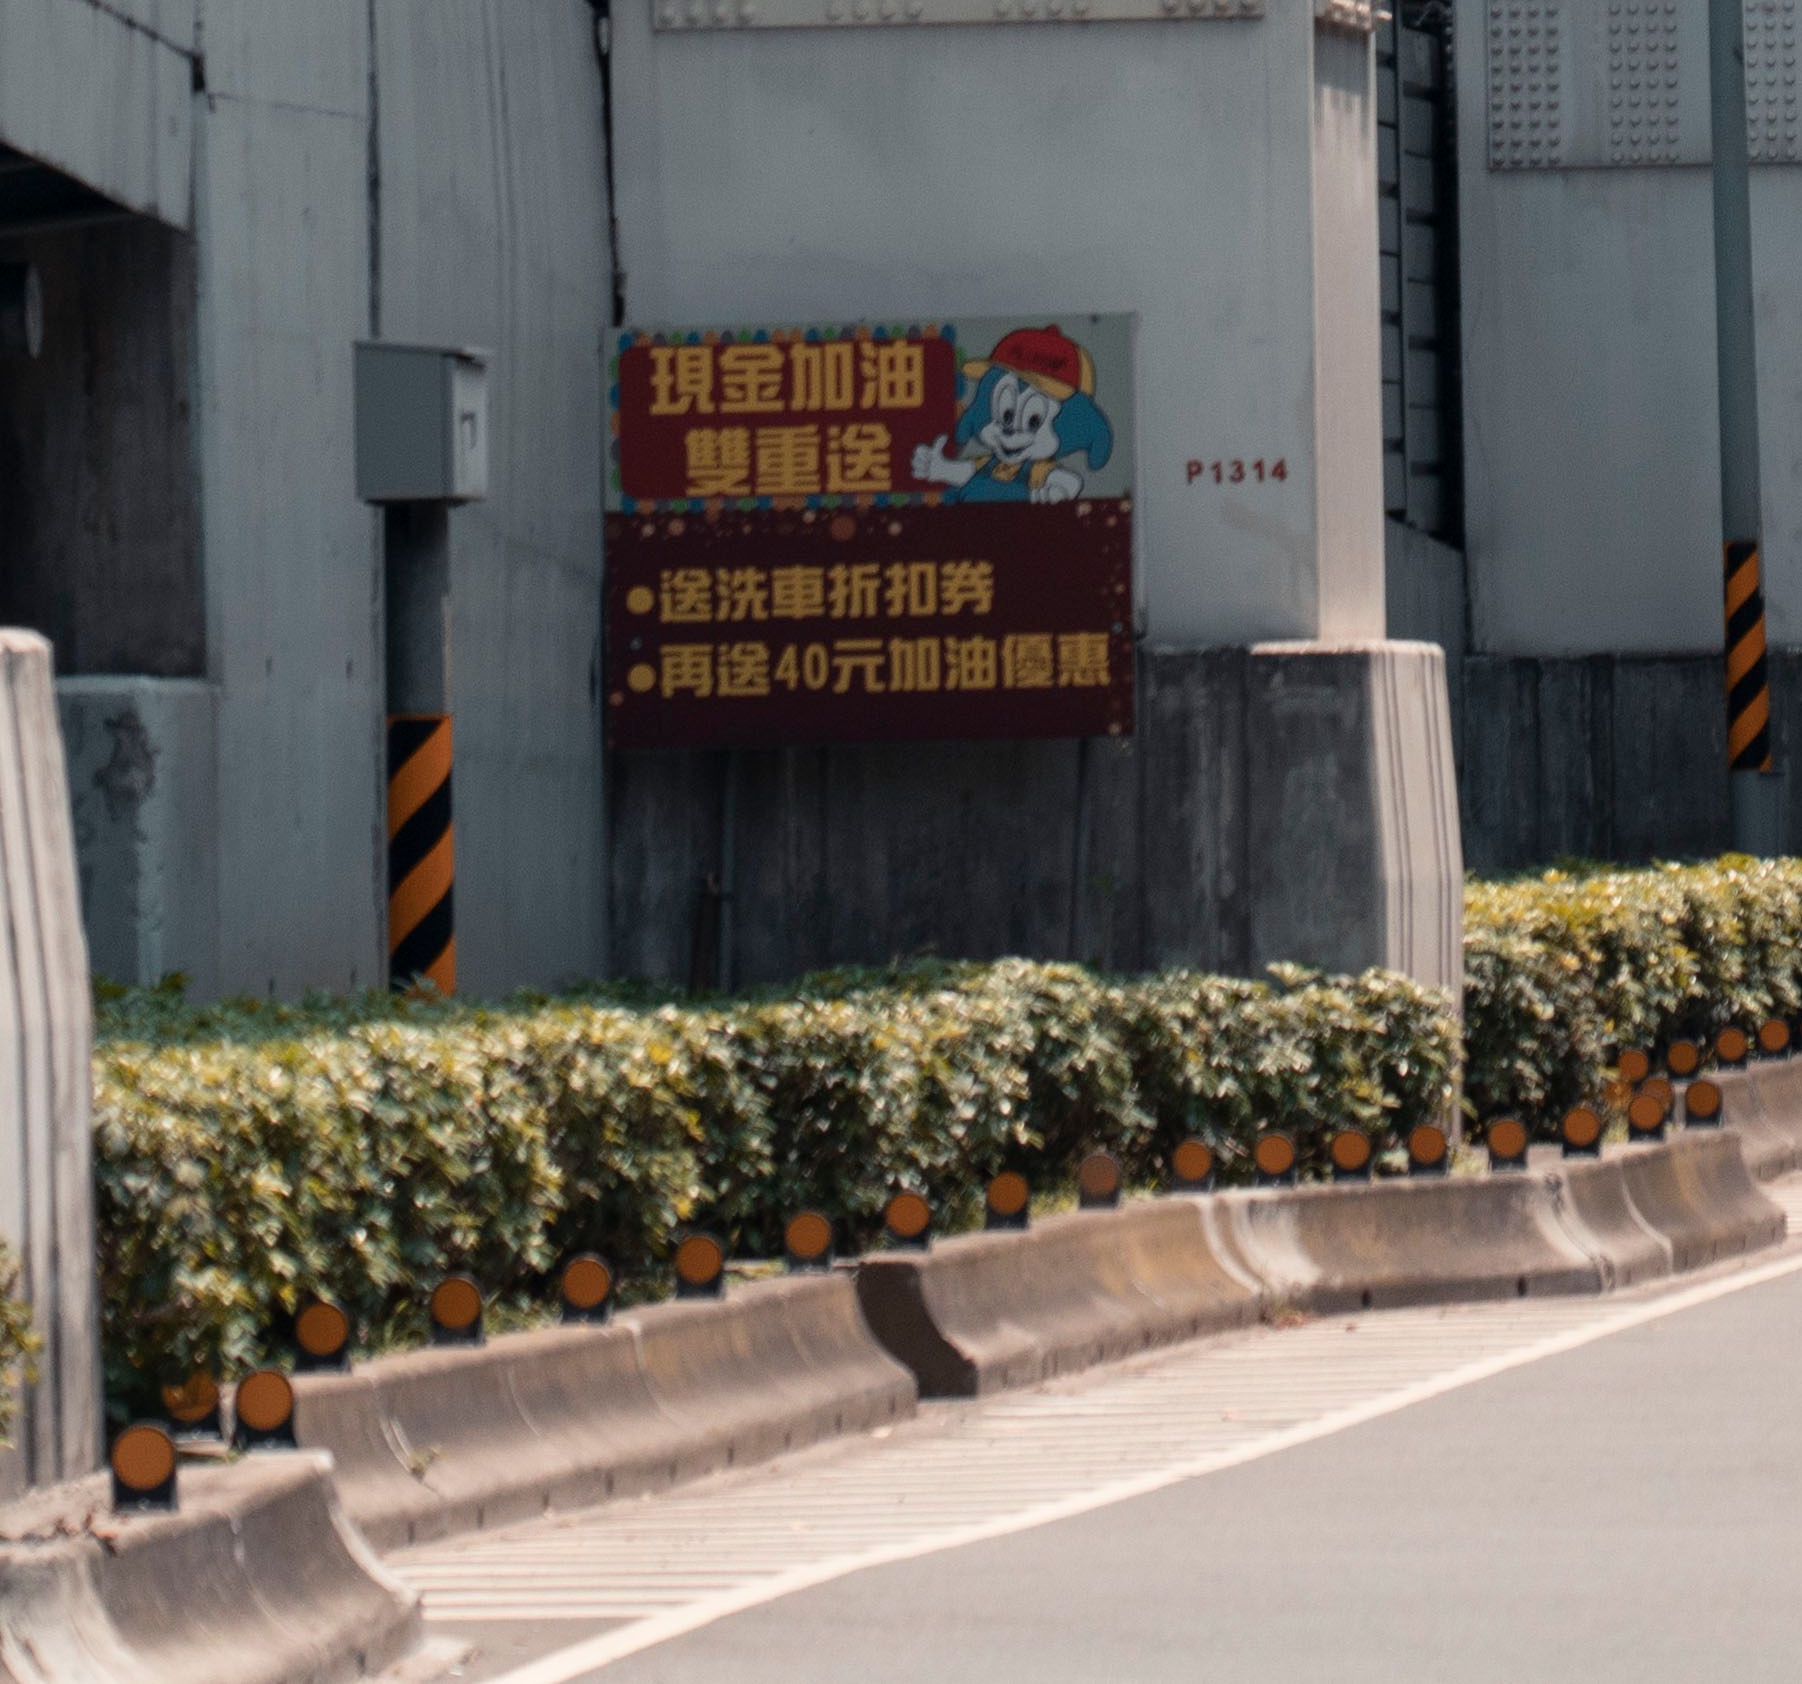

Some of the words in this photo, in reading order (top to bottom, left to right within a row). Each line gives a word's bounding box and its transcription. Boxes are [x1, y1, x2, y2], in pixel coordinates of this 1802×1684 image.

[650, 341, 925, 416] 現金加油
[686, 426, 892, 497] 雙重送
[1186, 456, 1288, 486] P1314
[659, 561, 994, 624] 送洗車折扣券
[659, 633, 1110, 698] 再送40元加油優惠
